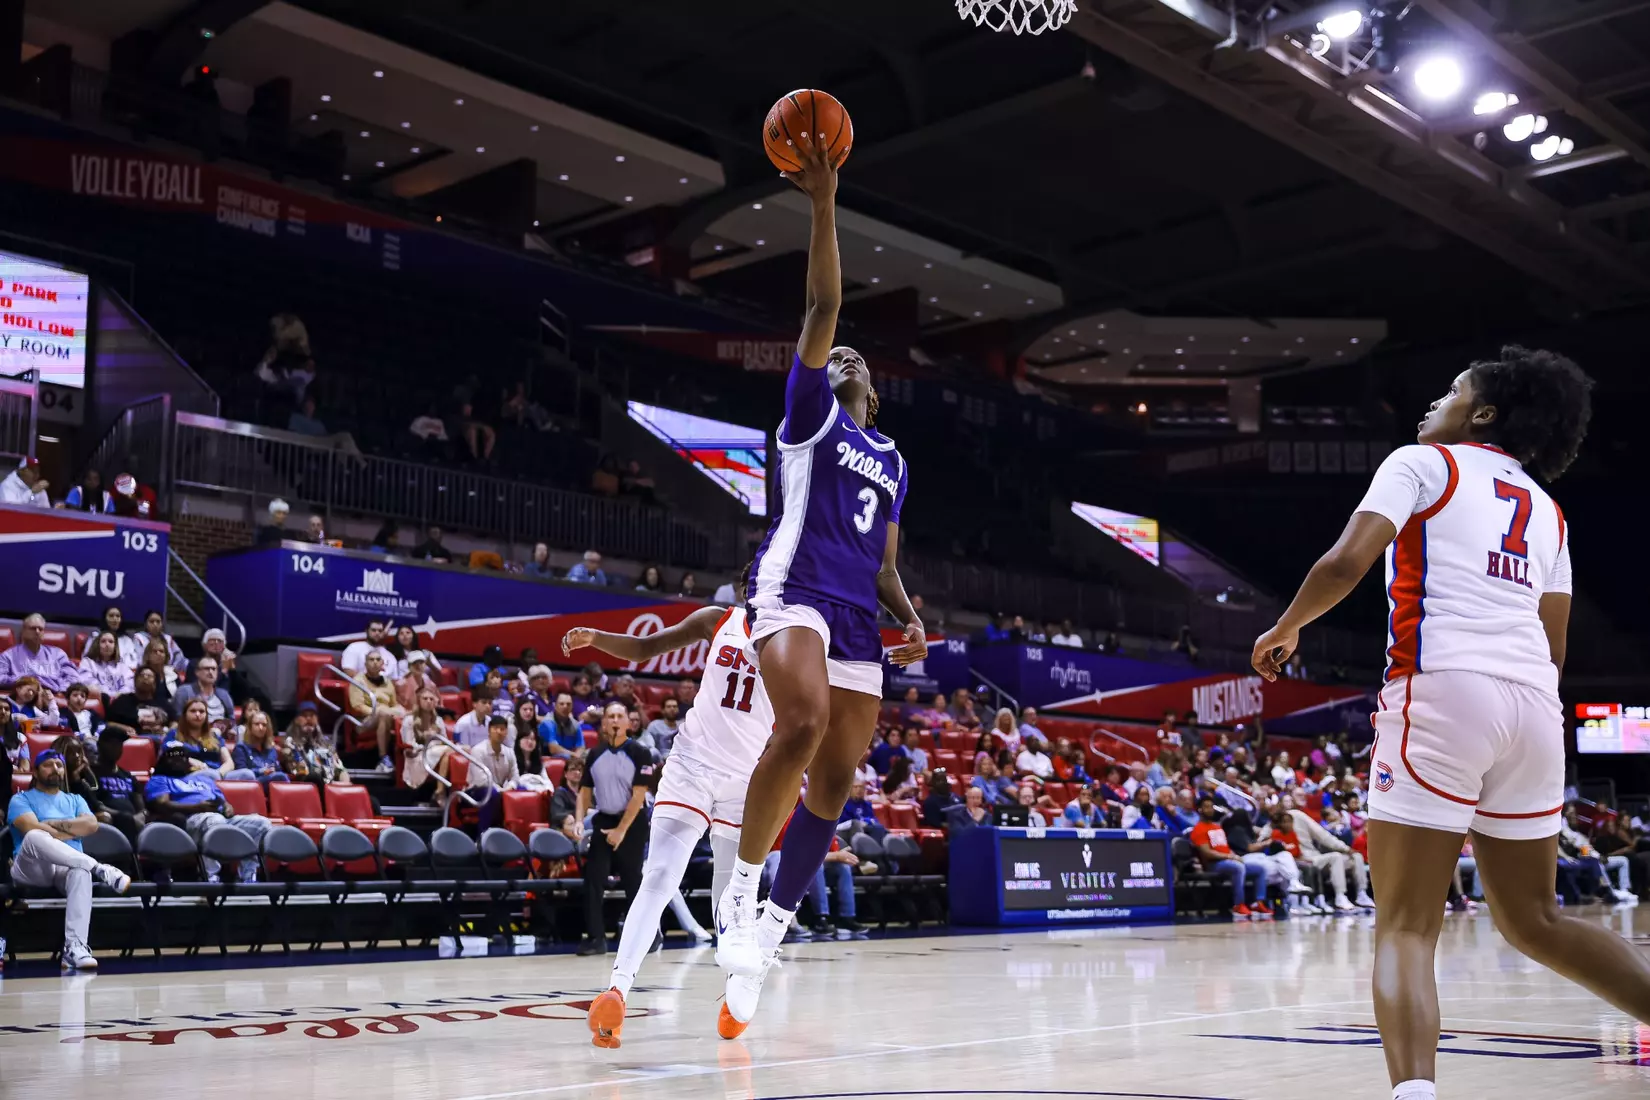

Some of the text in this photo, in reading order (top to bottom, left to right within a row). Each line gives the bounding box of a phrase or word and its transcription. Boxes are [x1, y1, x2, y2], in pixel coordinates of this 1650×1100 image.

[70, 153, 205, 205] VOLLEYBALL
[12, 282, 58, 304] PARK
[3, 313, 75, 338] HOLLOW
[21, 338, 70, 360] ROOM
[743, 340, 798, 371] BASKET
[853, 486, 879, 535] 3
[1493, 477, 1533, 559] 7
[122, 531, 159, 553] 103
[291, 554, 325, 575] 104
[1486, 550, 1533, 589] HALL
[38, 563, 125, 599] SMU
[715, 645, 758, 675] SM
[1050, 660, 1092, 689] rhythm
[721, 672, 756, 713] 11
[1192, 676, 1264, 724] MUSTANGS
[1060, 872, 1117, 889] VERITEX
[59, 1000, 664, 1046] Dallas
